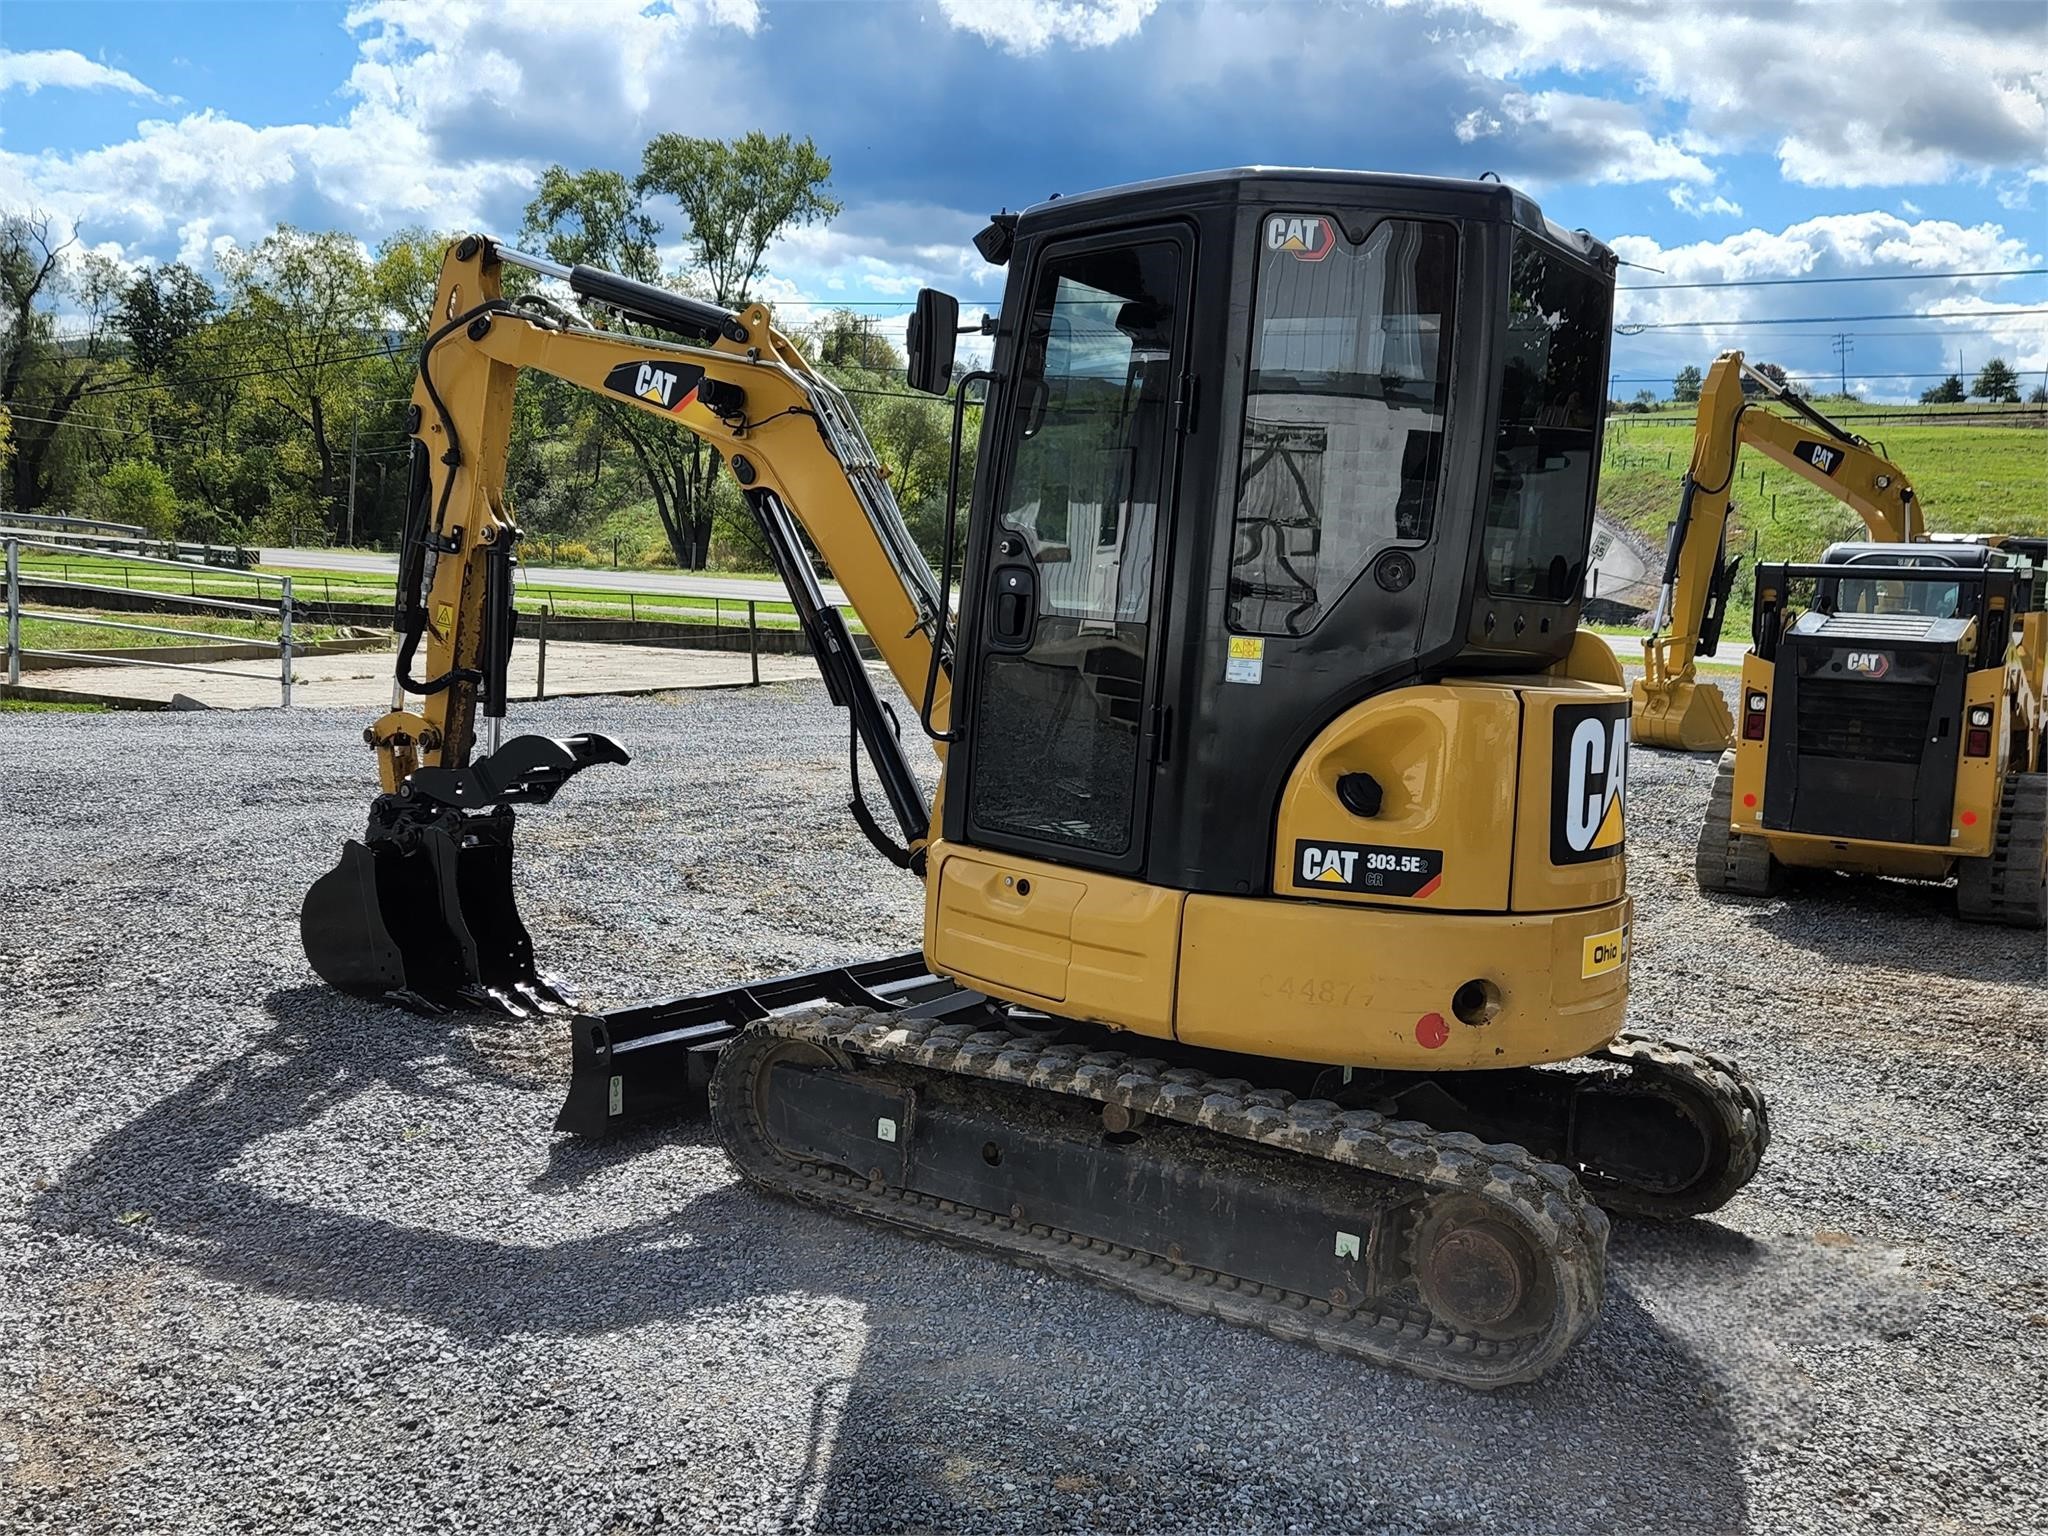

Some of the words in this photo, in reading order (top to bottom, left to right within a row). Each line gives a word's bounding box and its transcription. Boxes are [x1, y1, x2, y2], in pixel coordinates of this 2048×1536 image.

[1268, 218, 1319, 250] CAT
[635, 364, 677, 406] CAT
[1811, 445, 1834, 472] CAT
[1592, 544, 1605, 557] 35
[1847, 652, 1879, 671] CAT
[1302, 847, 1359, 884] CAT
[1365, 872, 1384, 886] CR
[1594, 942, 1617, 964] Ohio
